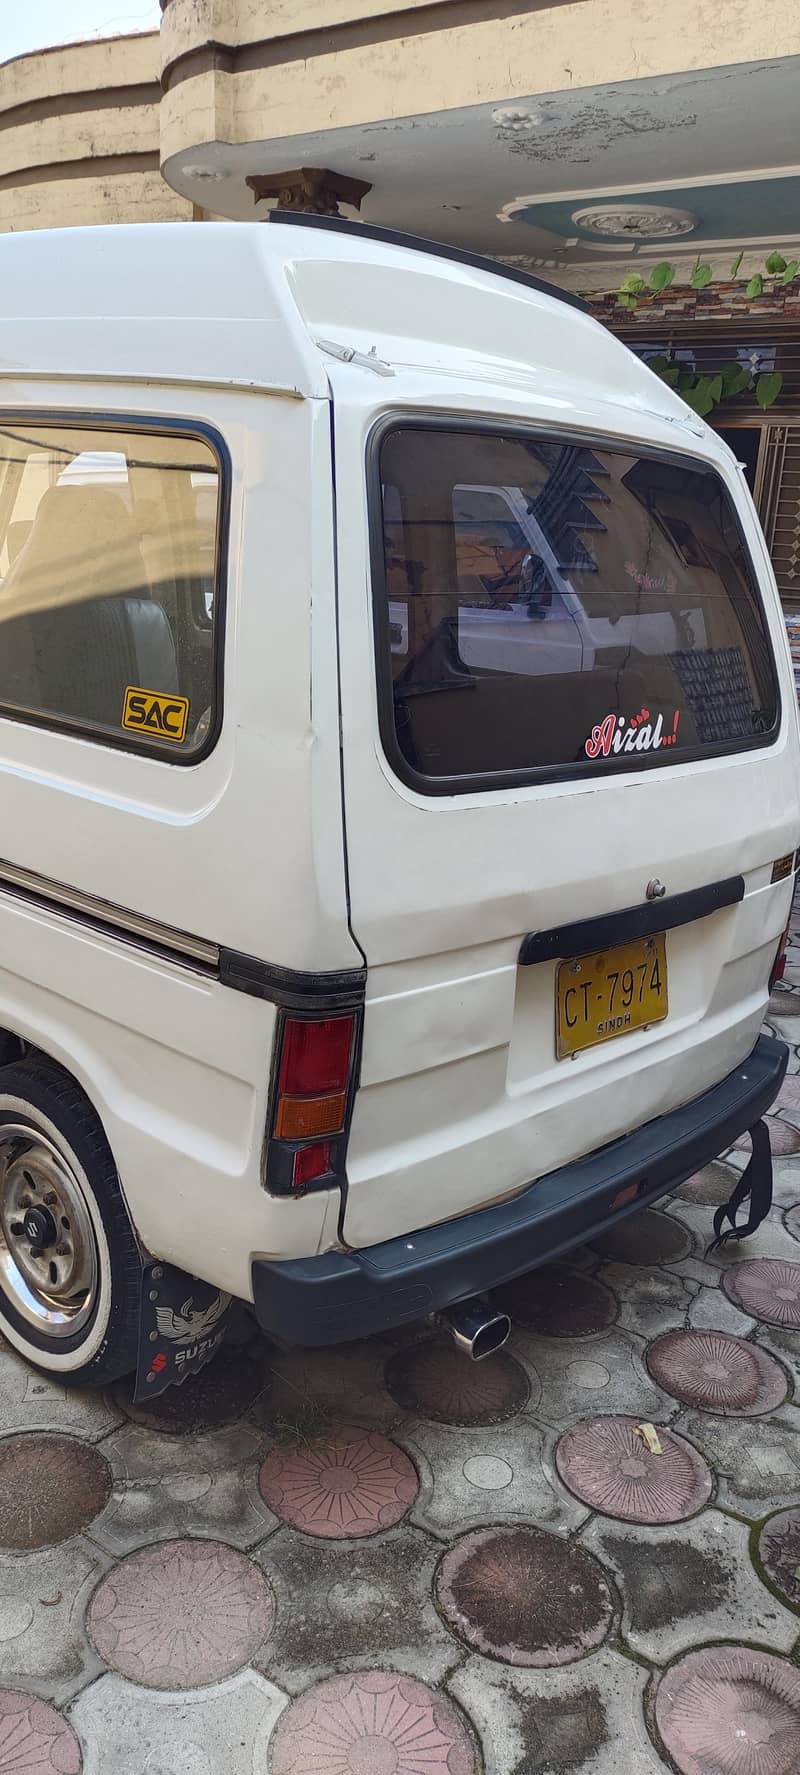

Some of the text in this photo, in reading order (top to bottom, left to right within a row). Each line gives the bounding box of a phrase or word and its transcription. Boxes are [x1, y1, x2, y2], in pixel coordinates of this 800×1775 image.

[127, 696, 183, 733] SAC
[564, 958, 662, 1028] CT-7974
[597, 1013, 631, 1034] SINDH
[174, 1331, 222, 1365] SUZU
